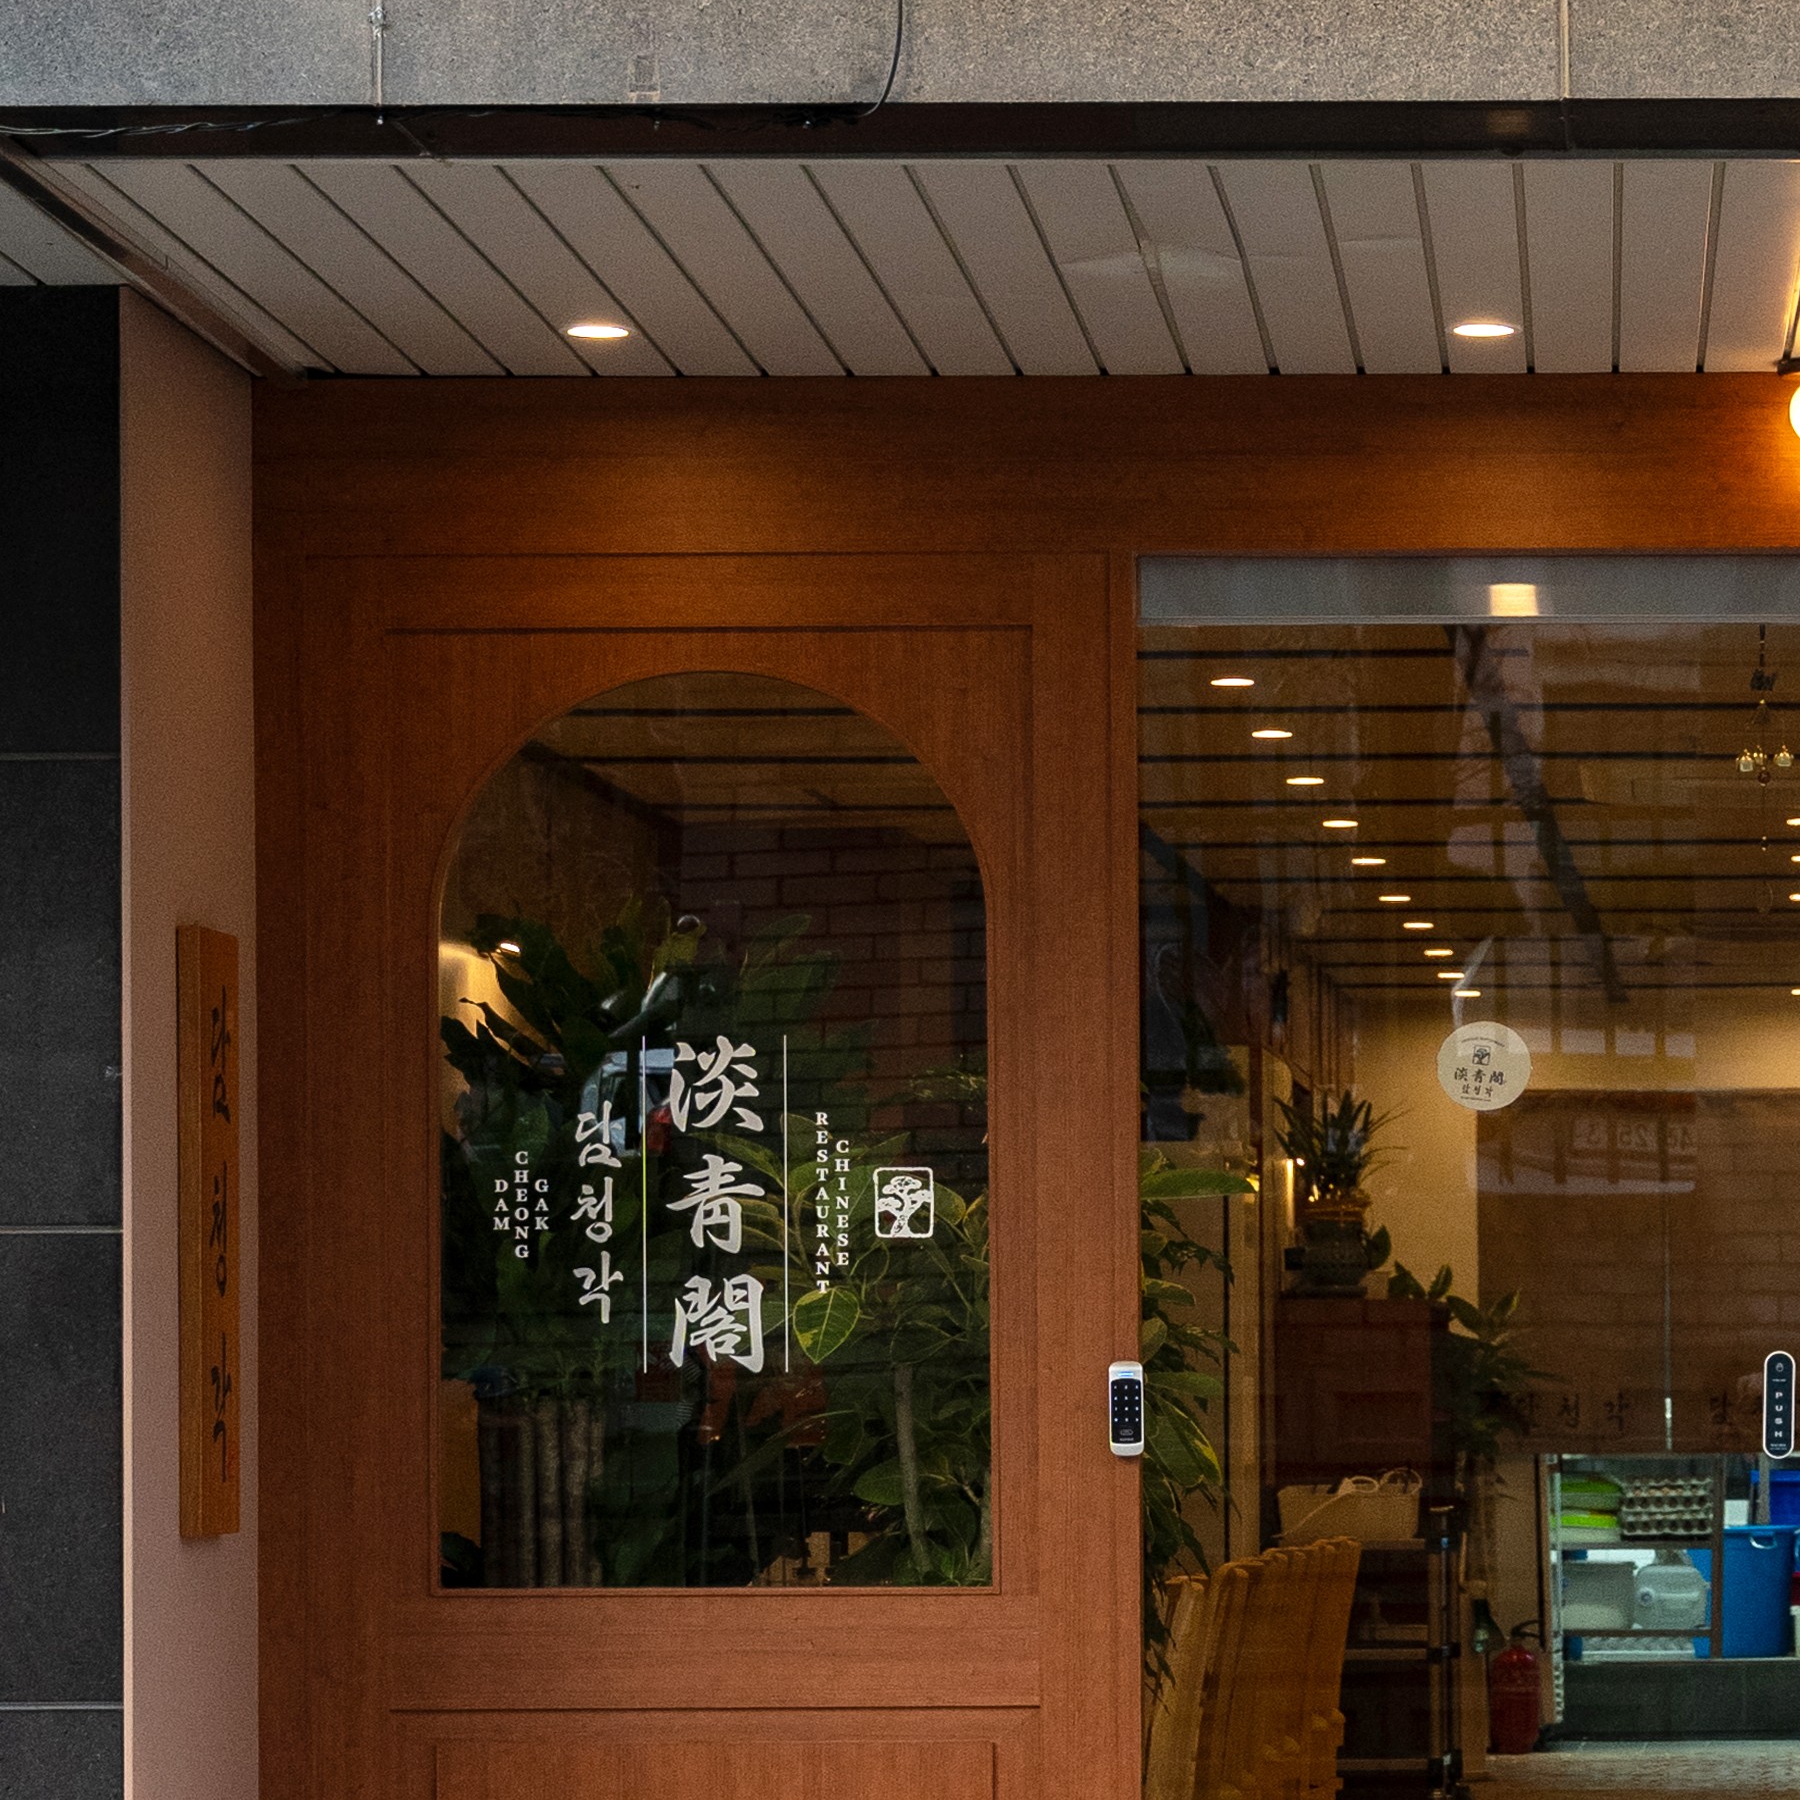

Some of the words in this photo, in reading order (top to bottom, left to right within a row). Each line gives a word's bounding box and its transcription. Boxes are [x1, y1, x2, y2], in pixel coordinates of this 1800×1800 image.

[493, 1179, 510, 1230] DAM
[514, 1151, 530, 1258] CHEONG
[534, 1178, 549, 1230] GAK
[570, 1100, 624, 1324] 담청각
[665, 1035, 766, 1373] 淡青閣
[815, 1112, 830, 1294] RESTAURANT
[834, 1140, 850, 1266] CHINESE
[1774, 1392, 1784, 1437] PUSH
